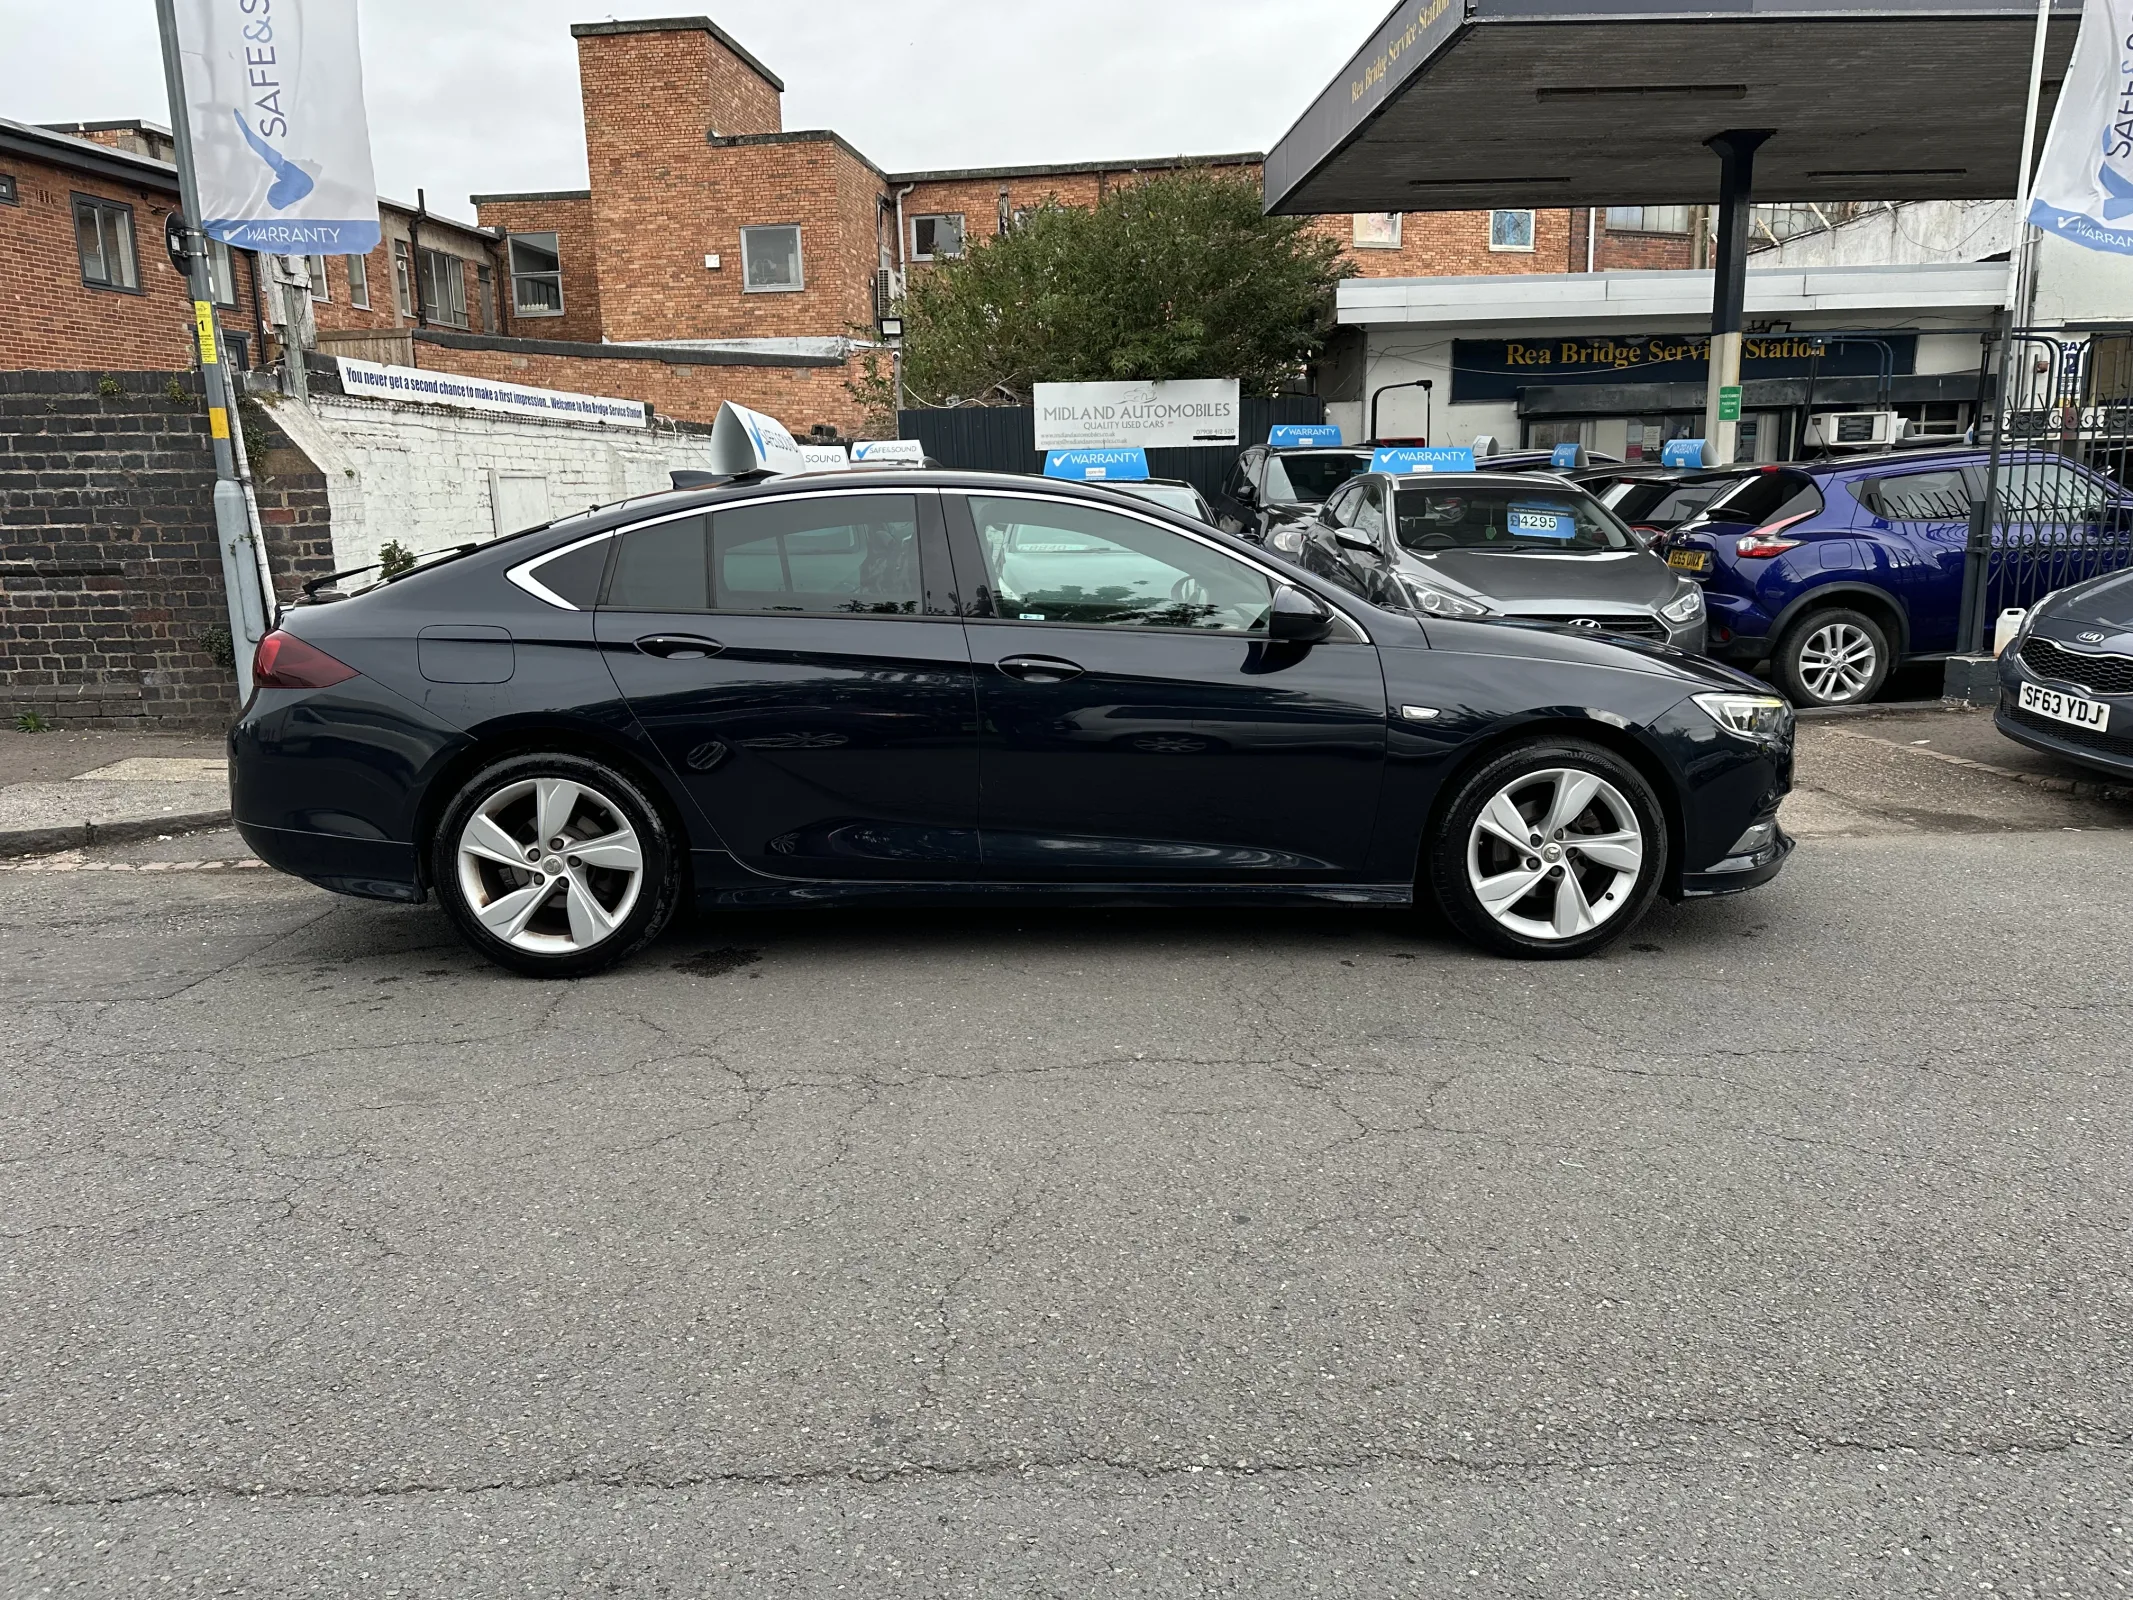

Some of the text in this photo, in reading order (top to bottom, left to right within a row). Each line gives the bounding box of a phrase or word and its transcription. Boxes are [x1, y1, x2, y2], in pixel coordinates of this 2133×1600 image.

[1351, 76, 1364, 104] Rea
[1365, 54, 1387, 90] Bridge
[1388, 22, 1417, 66] Service
[247, 227, 341, 243] WARRANTY
[199, 320, 205, 331] 1
[1505, 344, 1551, 365] Rea
[1560, 341, 1641, 368] Bridge
[1649, 339, 1709, 363] Servi
[346, 367, 362, 383] You
[364, 372, 387, 387] never
[390, 375, 402, 389] get
[404, 378, 409, 390] a
[411, 379, 438, 394] second
[439, 381, 465, 397] chance
[466, 385, 474, 398] to
[475, 387, 493, 401] make
[494, 390, 499, 401] a
[499, 389, 514, 403] first
[550, 397, 576, 411] Welcome
[576, 401, 582, 411] to
[582, 402, 592, 413] Rea
[592, 402, 608, 416] Bridge
[609, 405, 626, 417] Service
[626, 407, 642, 419] Station
[1043, 403, 1231, 421] MIDLAND AUTOMOBILES
[1083, 420, 1164, 431] QUALITY USED CARS
[1288, 428, 1336, 436] WARRANTY
[869, 446, 917, 454] SAFE&SOUND
[805, 455, 841, 463] SOUND
[1070, 452, 1139, 464] WARRANTY
[1398, 451, 1467, 462] WARRANTY
[2079, 632, 2099, 641] KIA
[2025, 686, 2101, 724] SF63 YDJ
